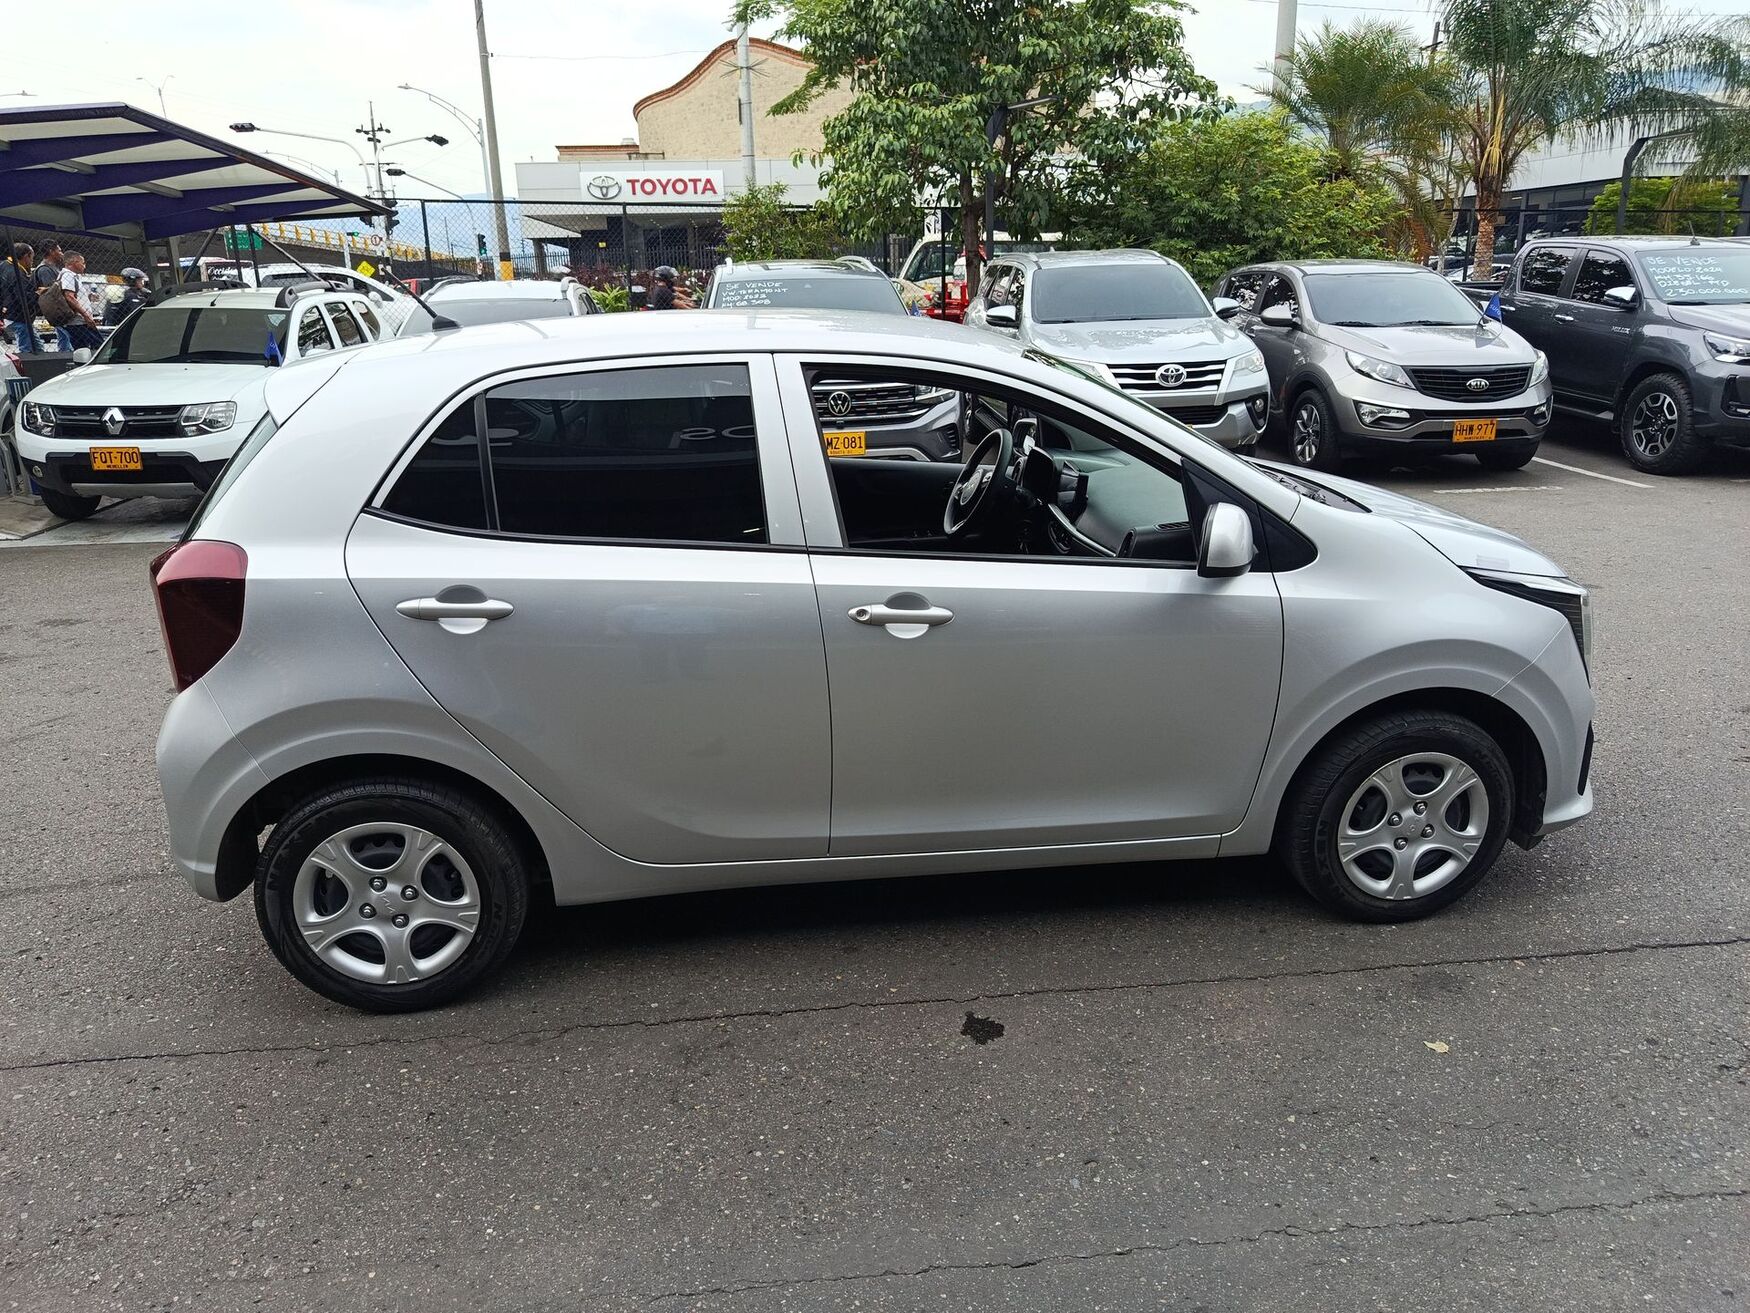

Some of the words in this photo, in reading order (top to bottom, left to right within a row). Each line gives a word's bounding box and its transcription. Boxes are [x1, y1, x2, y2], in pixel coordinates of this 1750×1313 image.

[626, 178, 718, 196] TOYOTA
[1646, 256, 1666, 264] SE
[1671, 256, 1718, 265] VENDE
